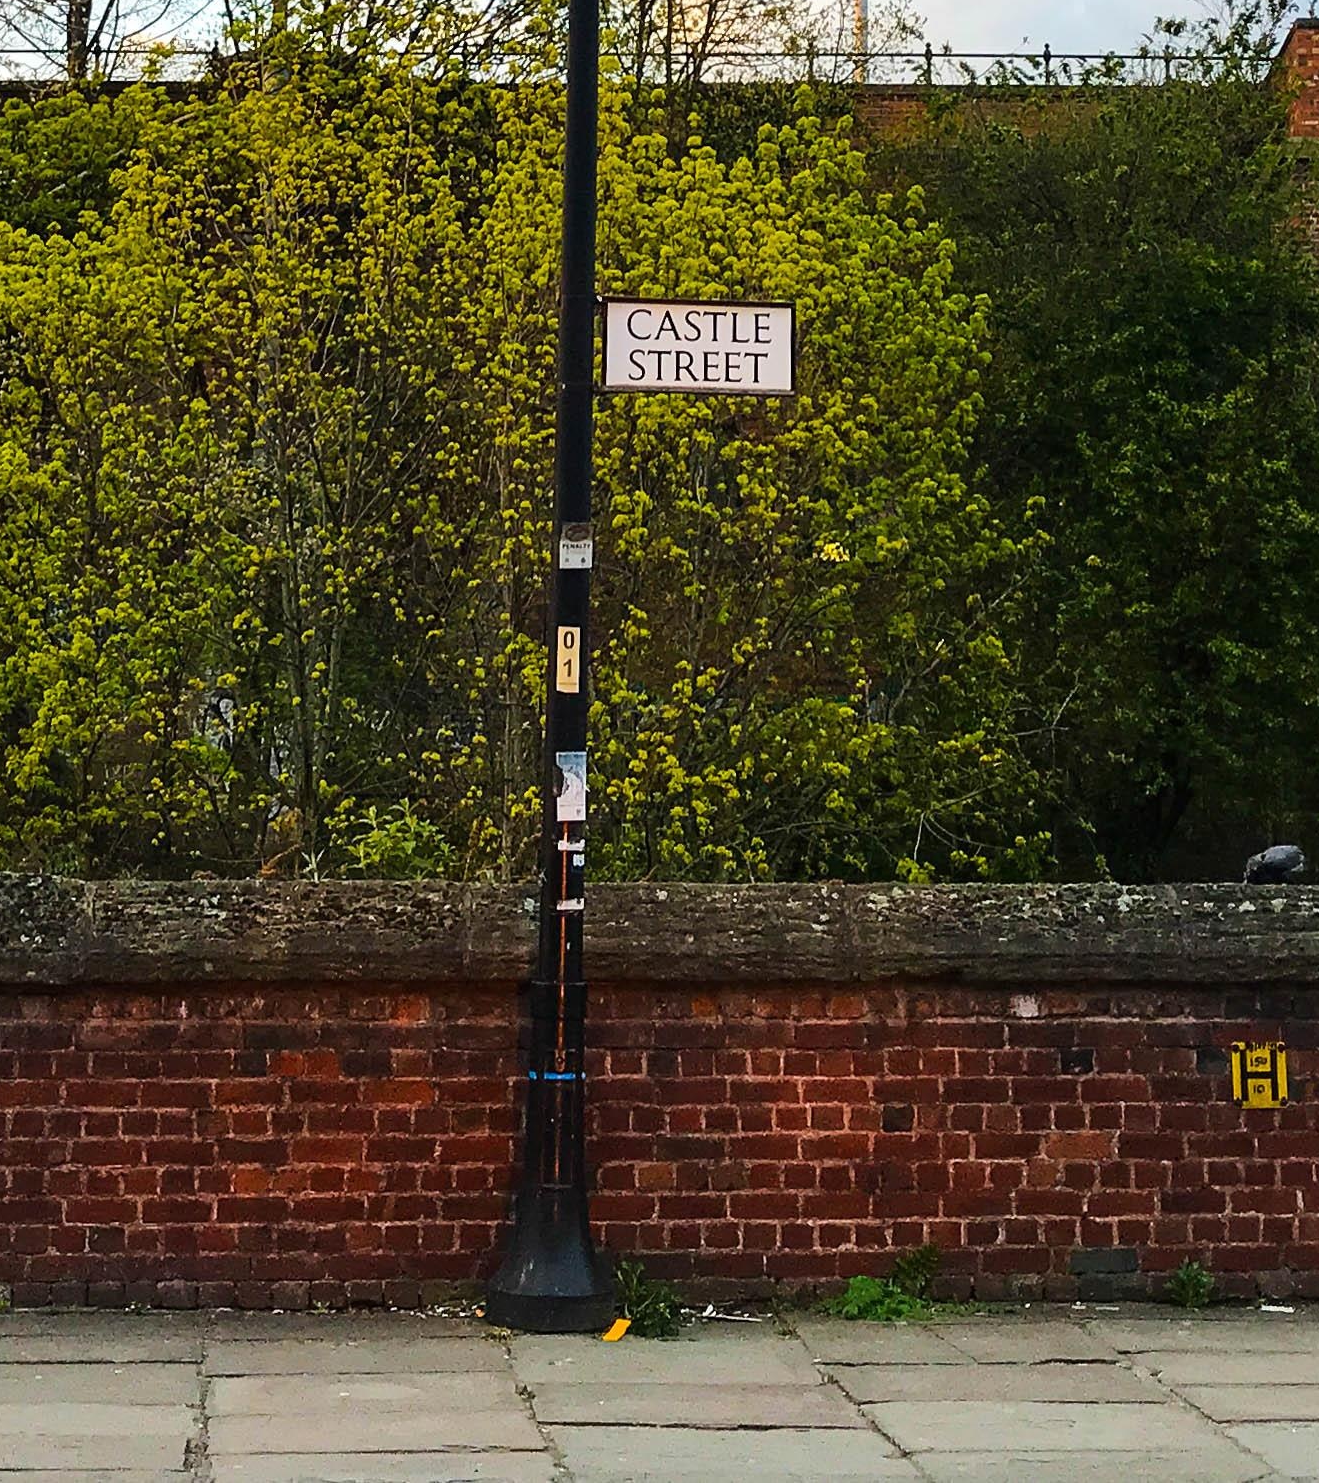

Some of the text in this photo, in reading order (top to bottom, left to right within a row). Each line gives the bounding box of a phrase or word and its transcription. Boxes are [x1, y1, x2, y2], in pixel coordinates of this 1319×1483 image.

[627, 309, 772, 344] CASTLE
[628, 349, 769, 384] STREET
[1253, 1084, 1265, 1094] 10
